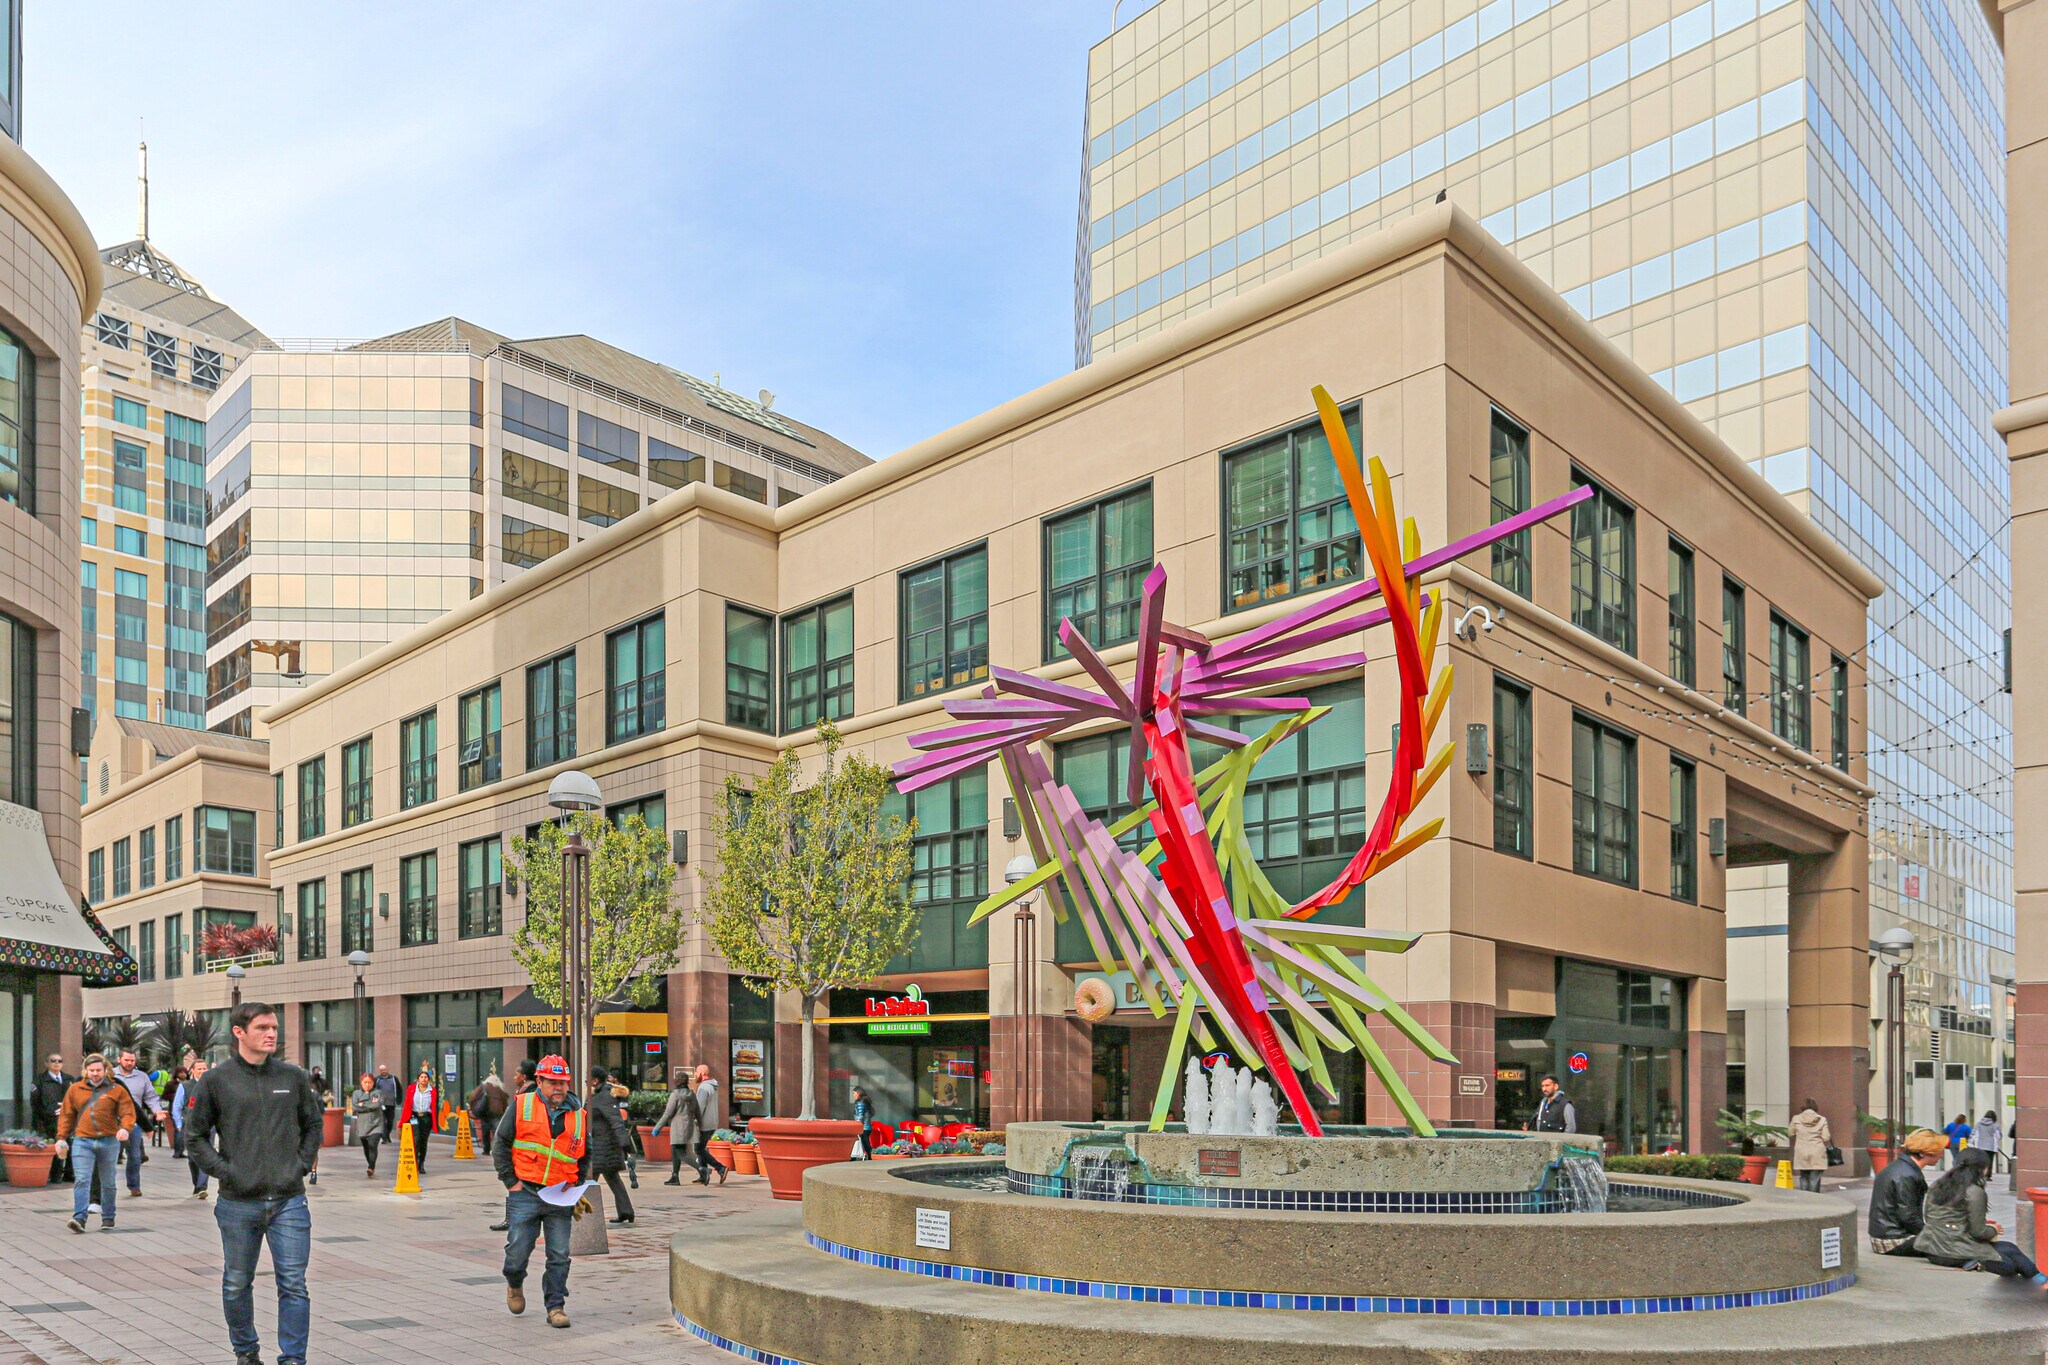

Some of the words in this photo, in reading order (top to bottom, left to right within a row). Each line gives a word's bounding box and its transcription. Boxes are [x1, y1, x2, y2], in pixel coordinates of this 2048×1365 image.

[6, 896, 69, 914] CUPCAKE
[15, 911, 56, 924] COVE
[503, 1020, 525, 1034] North
[527, 1019, 551, 1033] Beach
[552, 1018, 569, 1033] Dei
[870, 1024, 886, 1032] FRESH
[887, 1023, 909, 1031] MEXICAN
